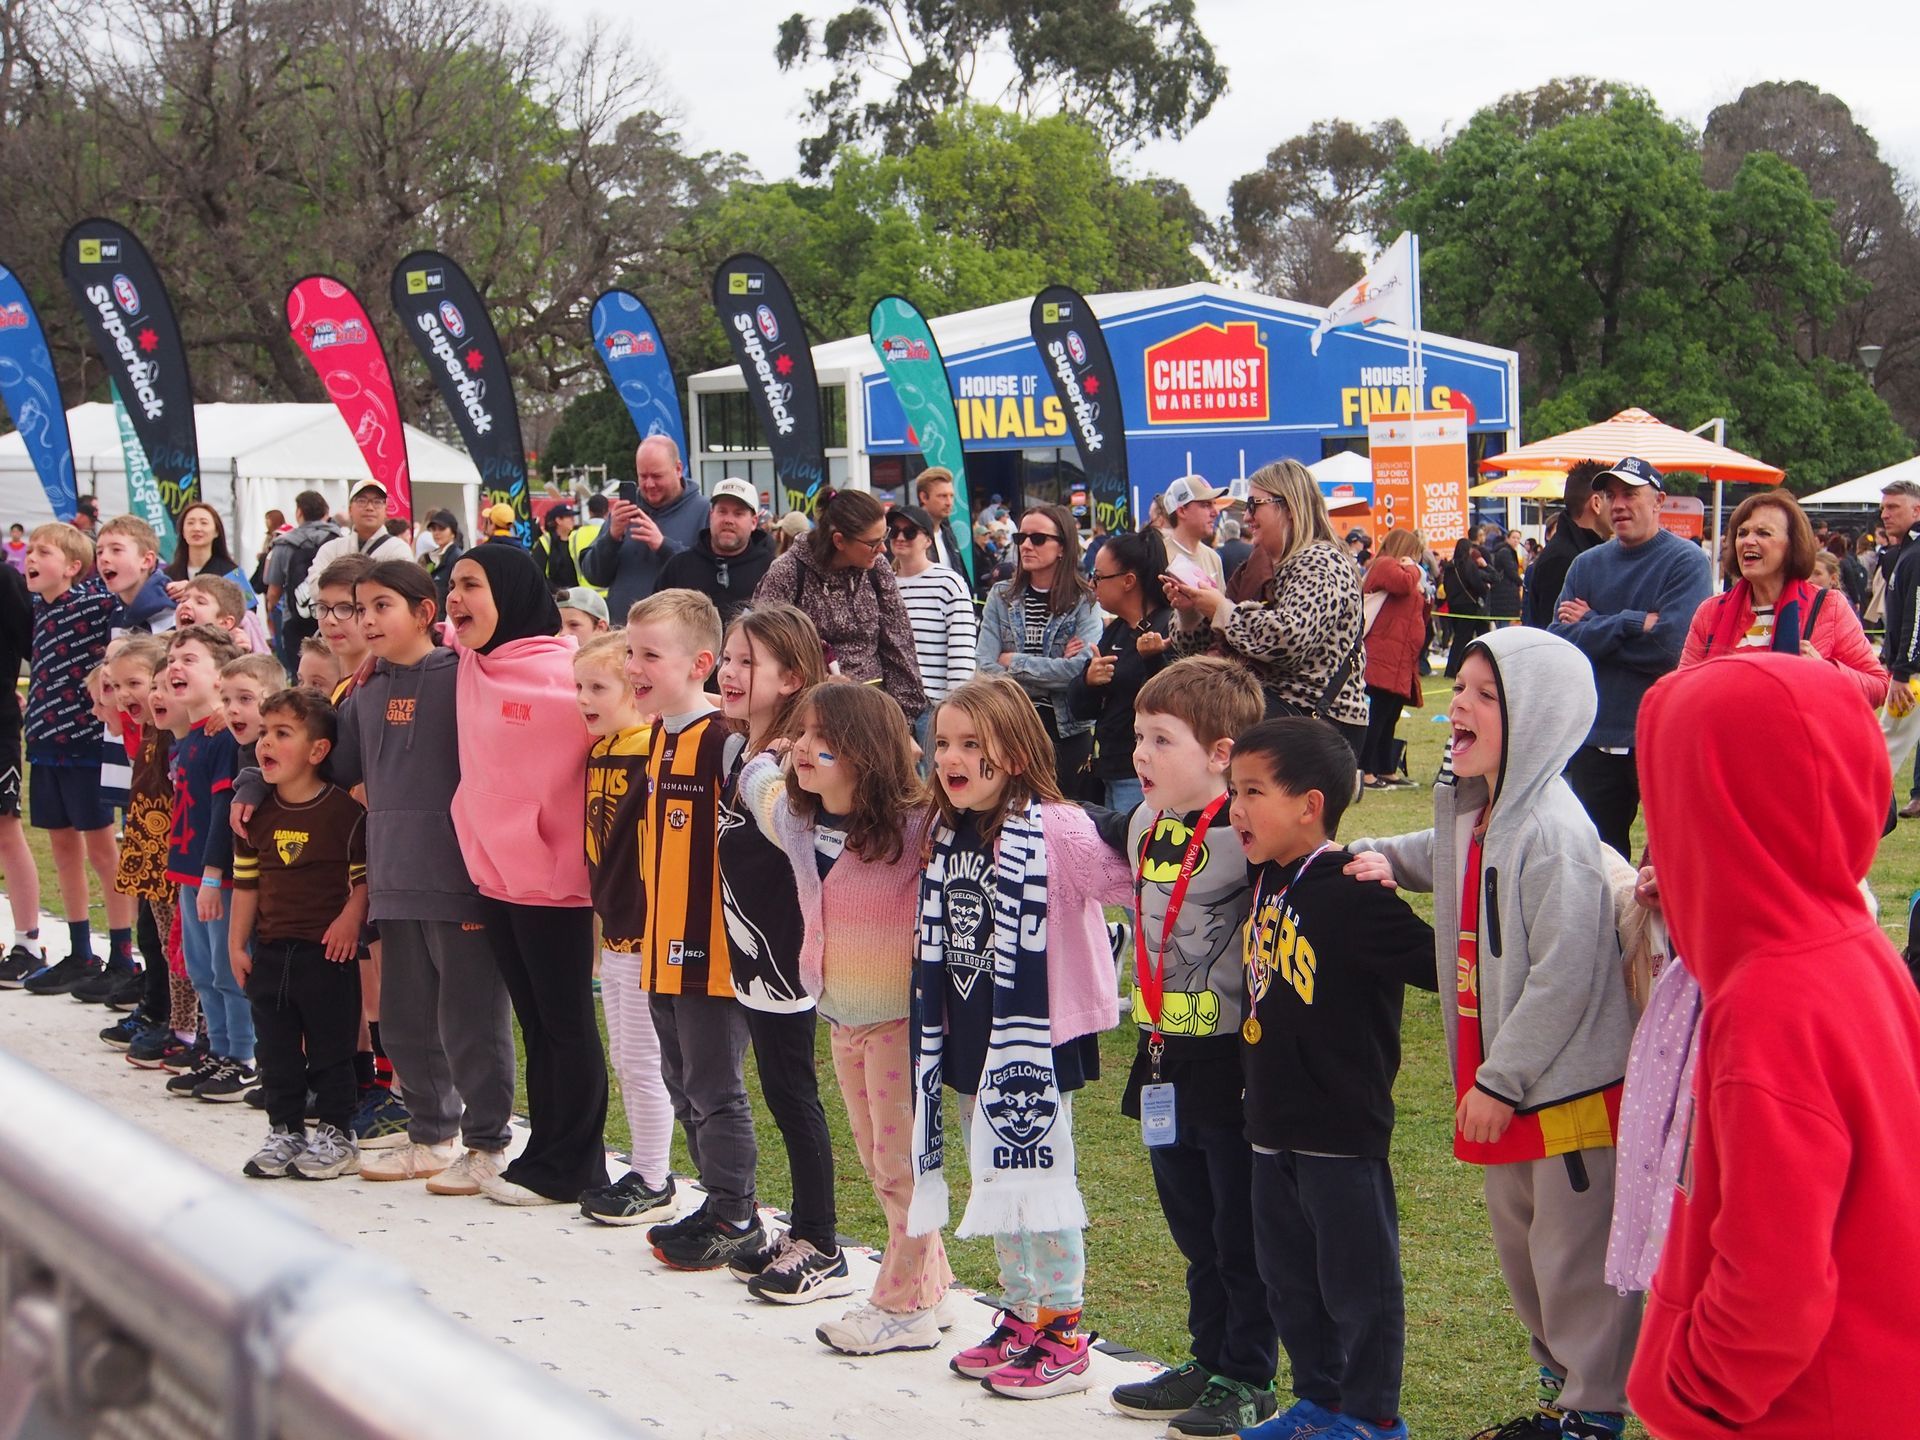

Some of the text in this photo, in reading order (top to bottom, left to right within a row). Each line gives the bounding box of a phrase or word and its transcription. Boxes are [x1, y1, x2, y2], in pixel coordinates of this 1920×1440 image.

[86, 285, 164, 422] Superkick
[416, 312, 493, 436] Superkick
[733, 313, 796, 436] Superkick
[1153, 358, 1261, 391] CHEMIST
[1361, 366, 1410, 386] HOUSE
[960, 375, 1038, 398] HOUSE OF
[1047, 341, 1105, 453] Superkick
[1155, 392, 1259, 410] WAREHOUSE
[954, 396, 1067, 440] INALS
[1422, 482, 1460, 498] YOUR
[1426, 497, 1458, 513] SKIN
[1421, 511, 1464, 528] KEEPS
[386, 709, 414, 722] GIRL
[388, 699, 416, 713] EVE
[589, 767, 629, 796] WKS
[661, 782, 705, 793] TASMANIAN
[273, 829, 310, 843] HAWKS
[1181, 843, 1200, 881] FAMILY
[951, 892, 981, 904] GEELONG
[951, 932, 976, 951] CATS
[964, 954, 992, 970] HOOPS
[992, 1065, 1051, 1085] GEELONG
[992, 1146, 1054, 1170] CATS
